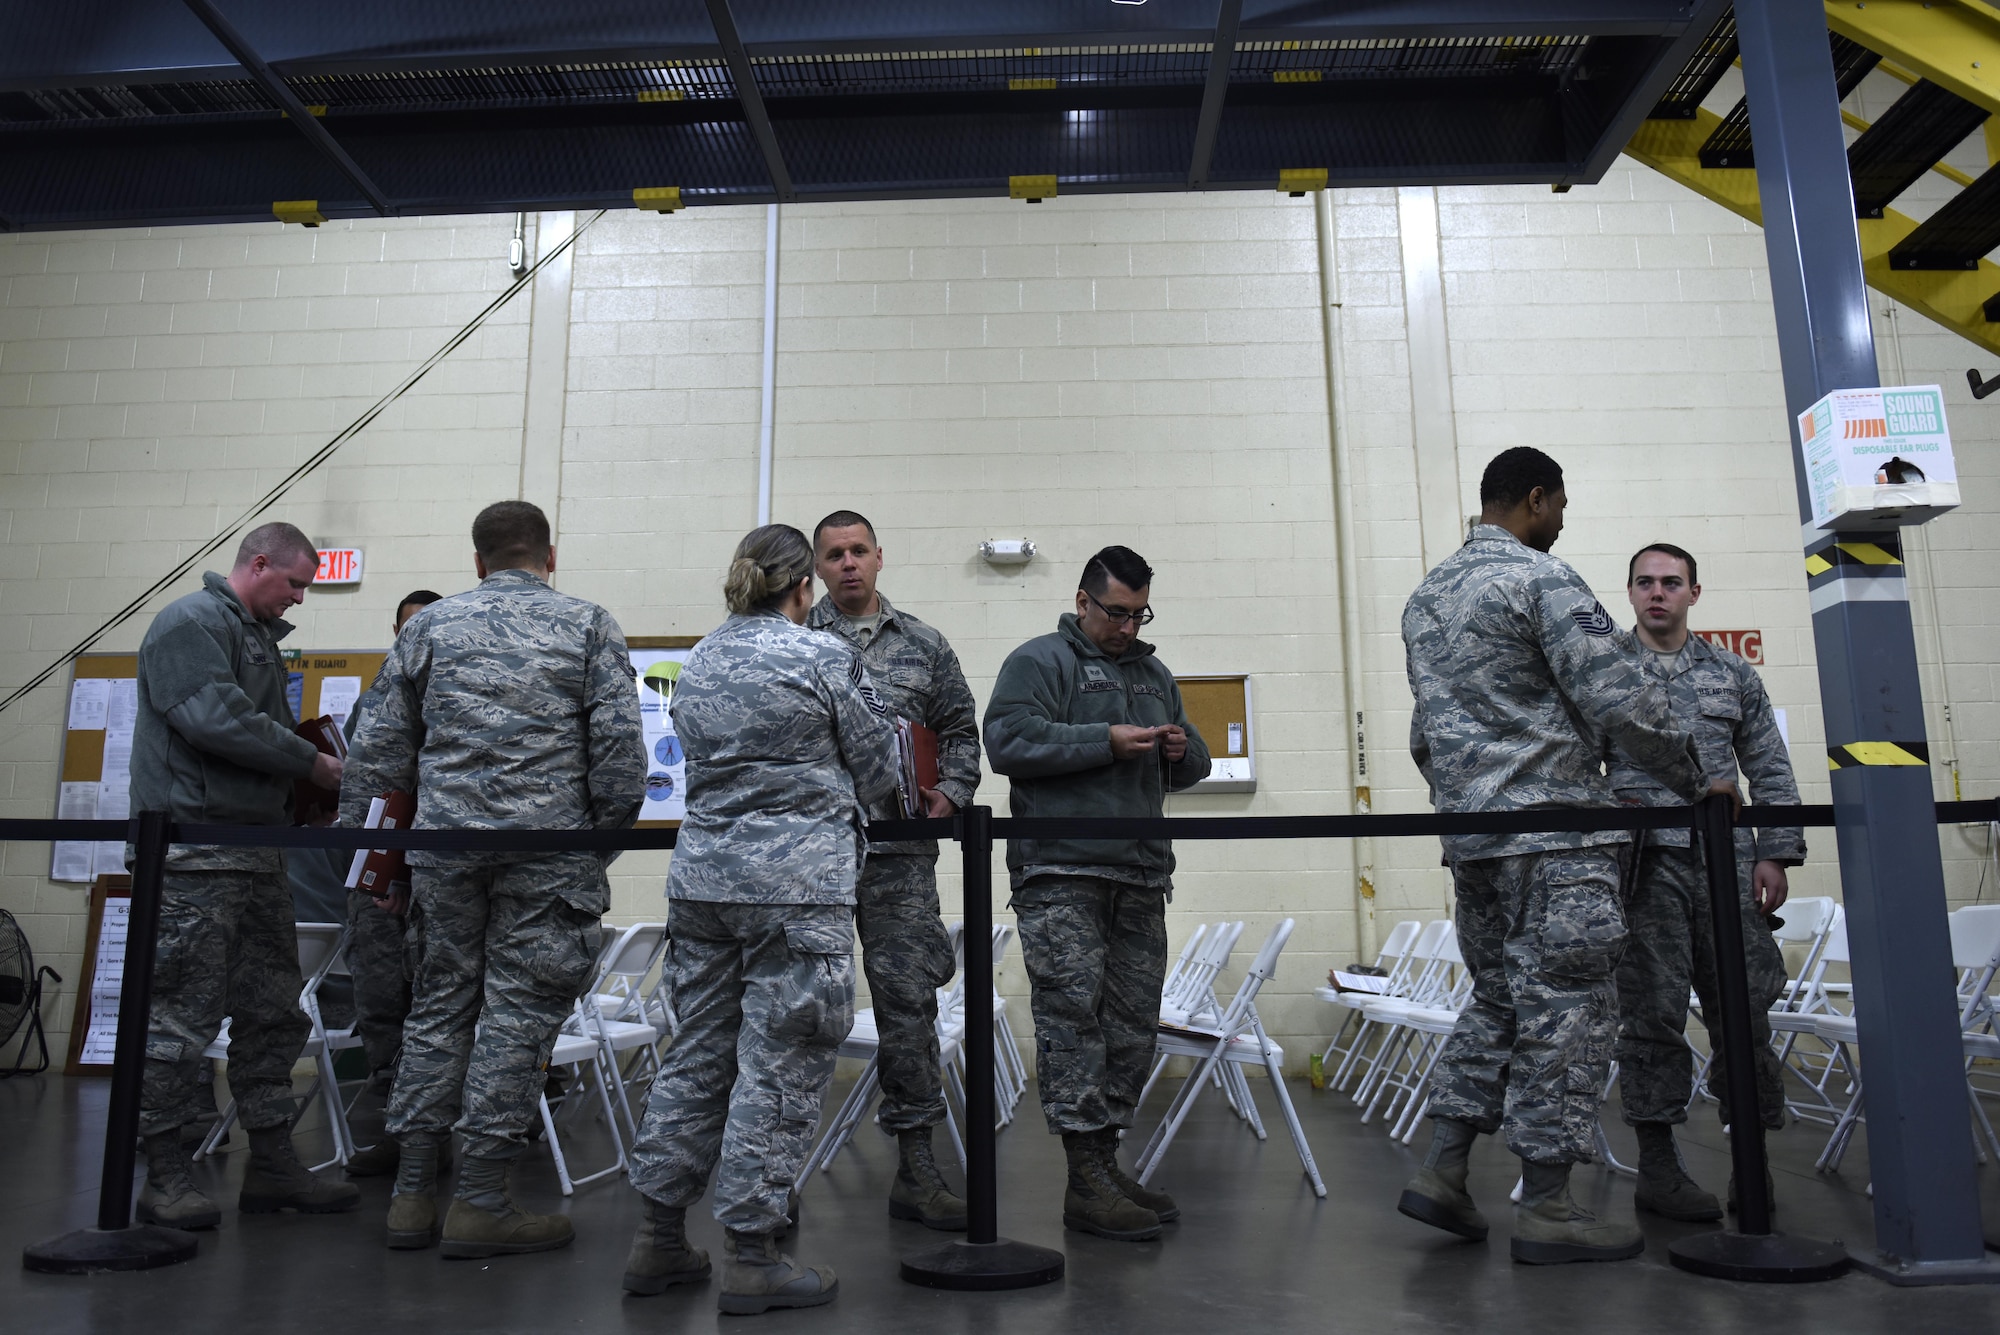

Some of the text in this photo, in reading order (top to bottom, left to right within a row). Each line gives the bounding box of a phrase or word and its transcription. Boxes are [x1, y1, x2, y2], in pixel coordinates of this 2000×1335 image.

[1885, 395, 1935, 414] SOUND
[1889, 413, 1938, 433] GUARD
[1853, 443, 1940, 455] DISPOSABLE EAR PLUGS
[316, 551, 353, 580] EXIT
[314, 658, 347, 669] BOARD
